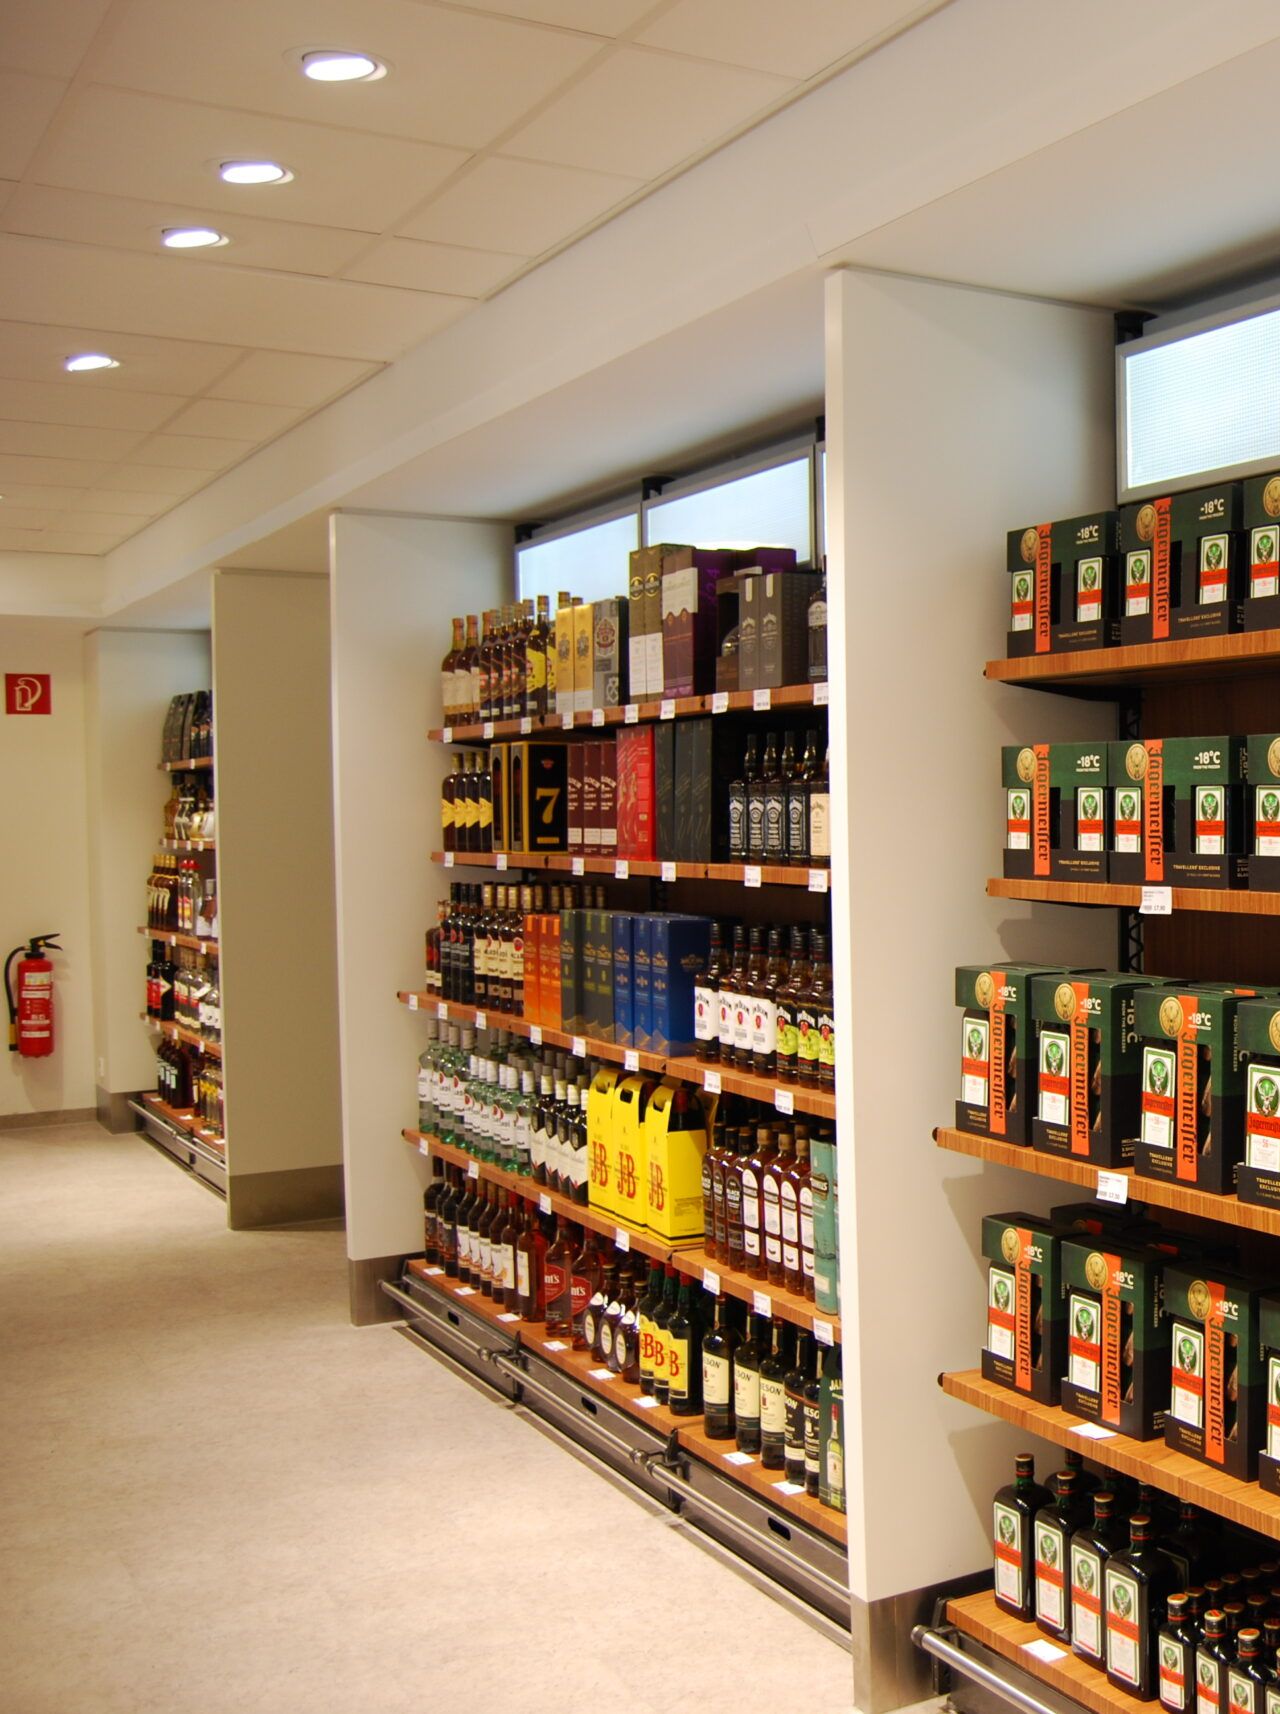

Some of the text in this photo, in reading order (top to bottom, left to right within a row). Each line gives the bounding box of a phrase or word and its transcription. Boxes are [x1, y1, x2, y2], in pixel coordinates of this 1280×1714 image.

[1200, 499, 1225, 514] -18°C
[1076, 754, 1101, 768] -18°C
[1194, 751, 1221, 765] -18°C
[536, 788, 560, 824] 7
[1080, 997, 1101, 1010] -18°C
[1188, 1012, 1212, 1026] -18°C
[1113, 1271, 1134, 1285] -18°C
[1216, 1301, 1239, 1316] -18°C
